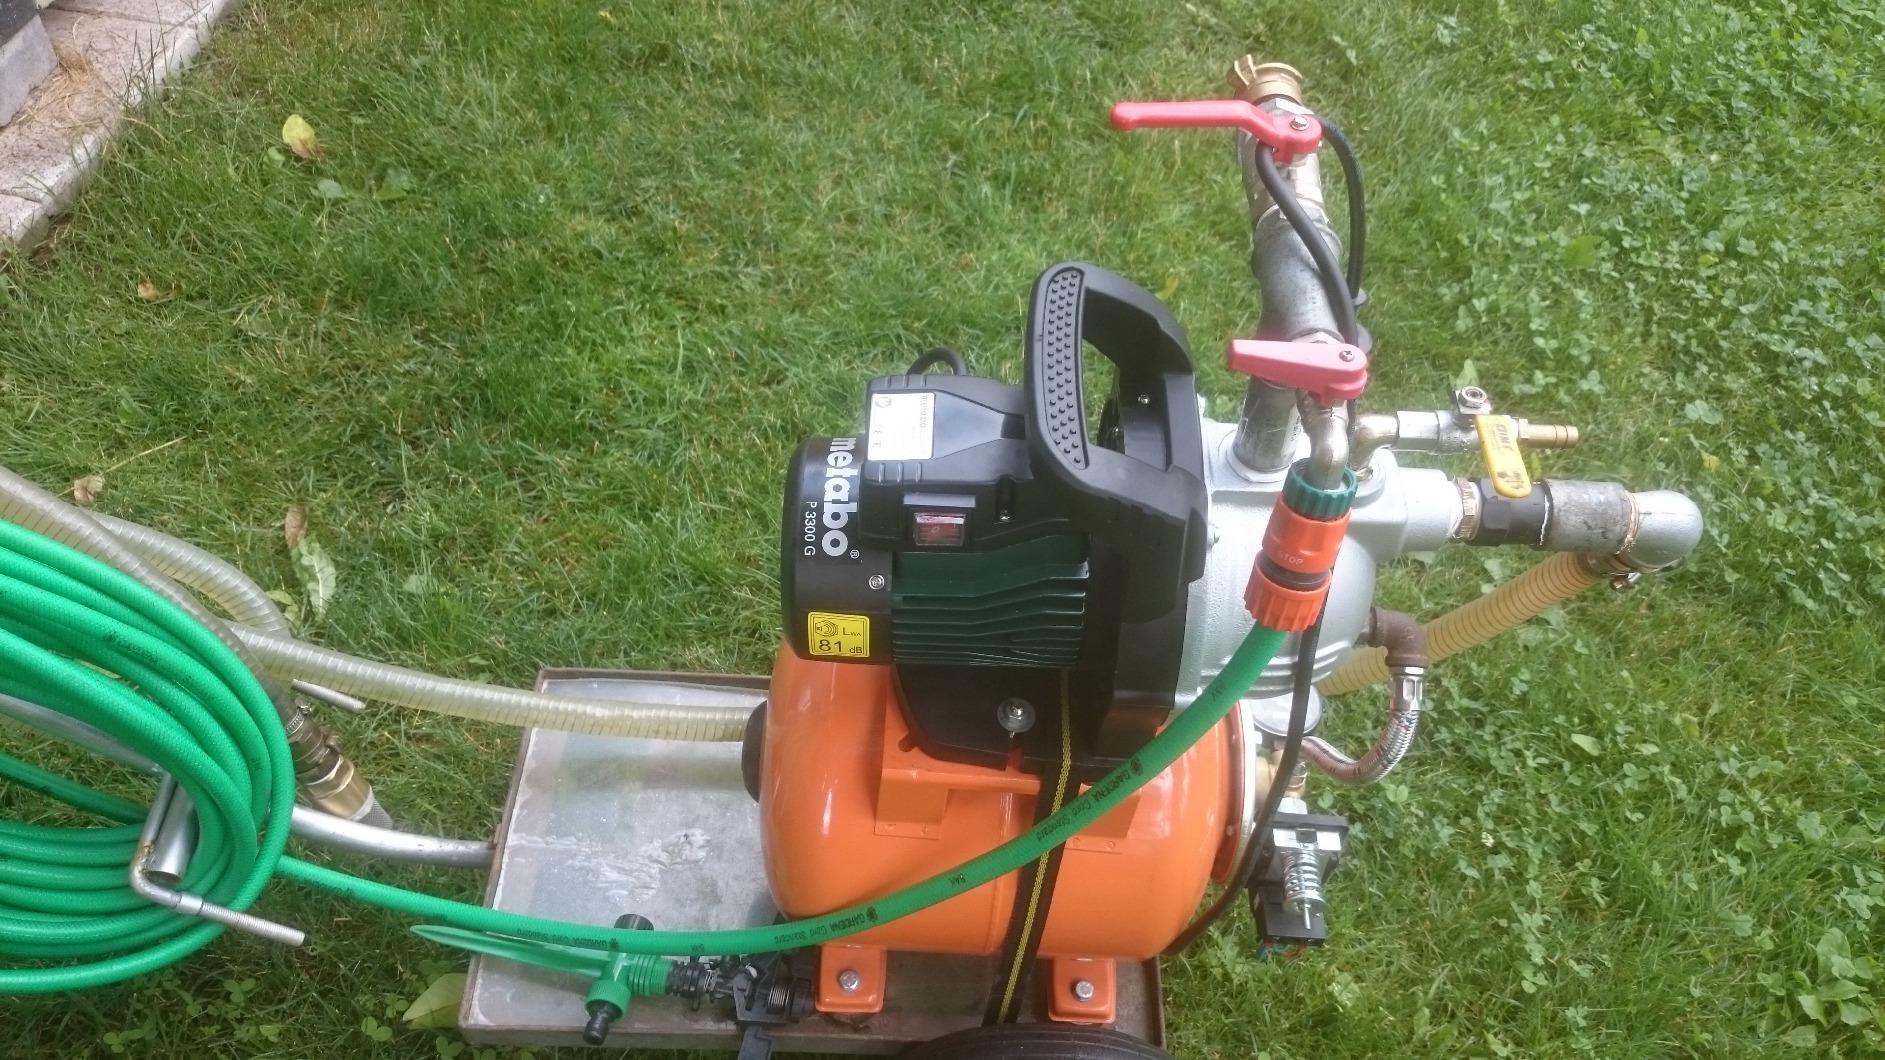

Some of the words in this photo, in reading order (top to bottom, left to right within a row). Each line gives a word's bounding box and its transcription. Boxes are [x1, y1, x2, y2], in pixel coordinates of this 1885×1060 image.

[804, 511, 817, 542] 3300
[804, 546, 816, 556] G
[818, 639, 842, 652] 81
[849, 645, 863, 654] dB
[829, 913, 866, 933] GARDENA
